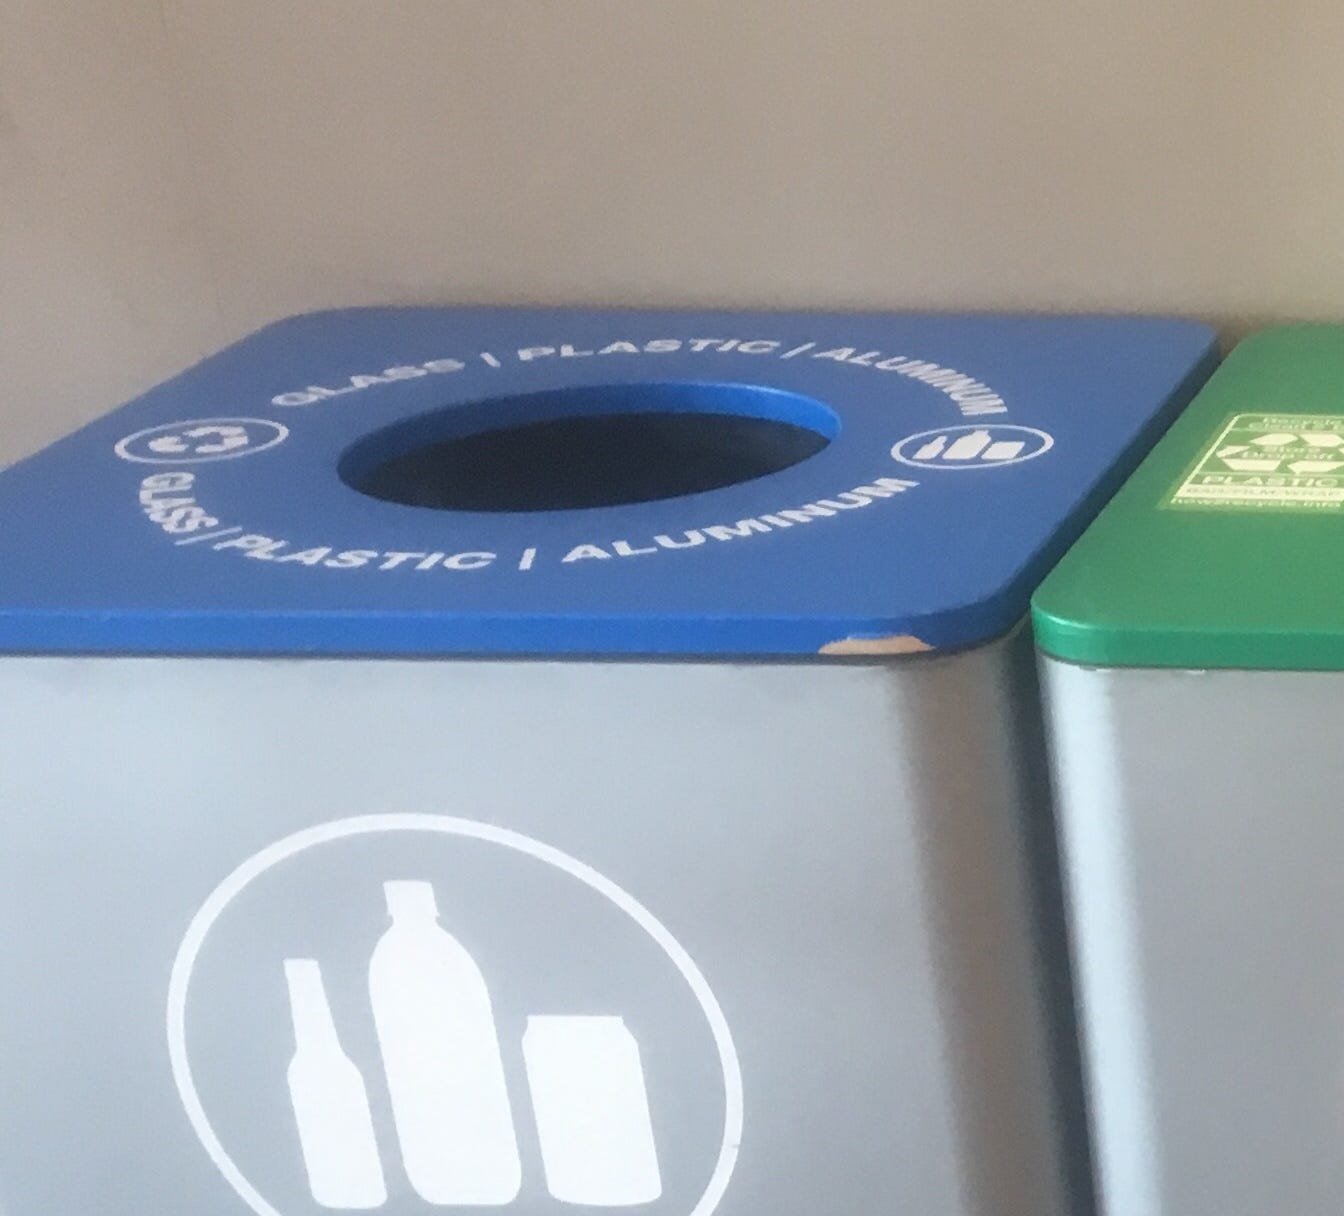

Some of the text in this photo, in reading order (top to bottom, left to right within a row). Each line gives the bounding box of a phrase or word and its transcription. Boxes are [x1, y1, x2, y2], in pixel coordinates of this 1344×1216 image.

[272, 338, 1008, 417] GLASS PLASTIC ALUMINUM
[1201, 475, 1339, 488] PLASTIC
[138, 471, 921, 572] GLASS PLASTIC ALUMINUM
